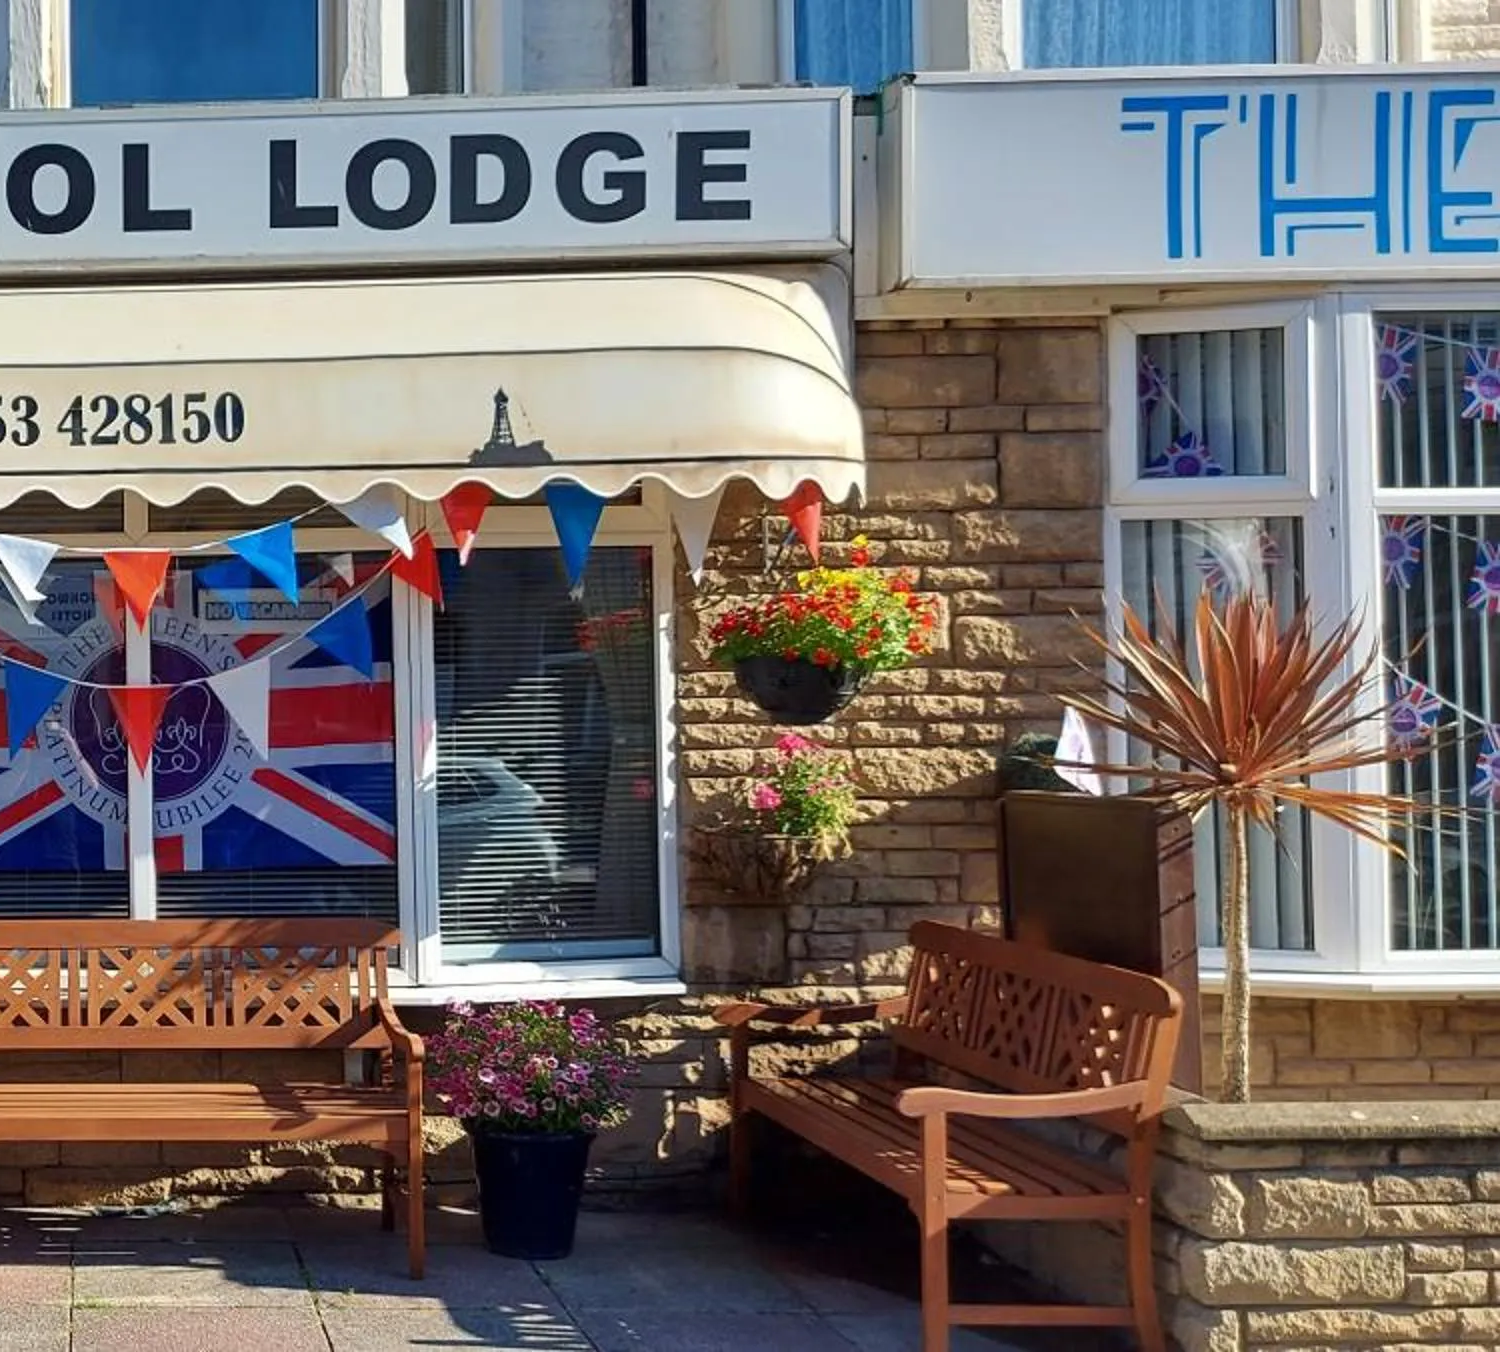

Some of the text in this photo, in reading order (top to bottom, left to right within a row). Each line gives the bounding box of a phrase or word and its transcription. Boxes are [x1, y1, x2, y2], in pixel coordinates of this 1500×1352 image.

[269, 130, 752, 231] LODGE
[57, 391, 245, 447] 428150
[155, 764, 243, 829] UBILEE
